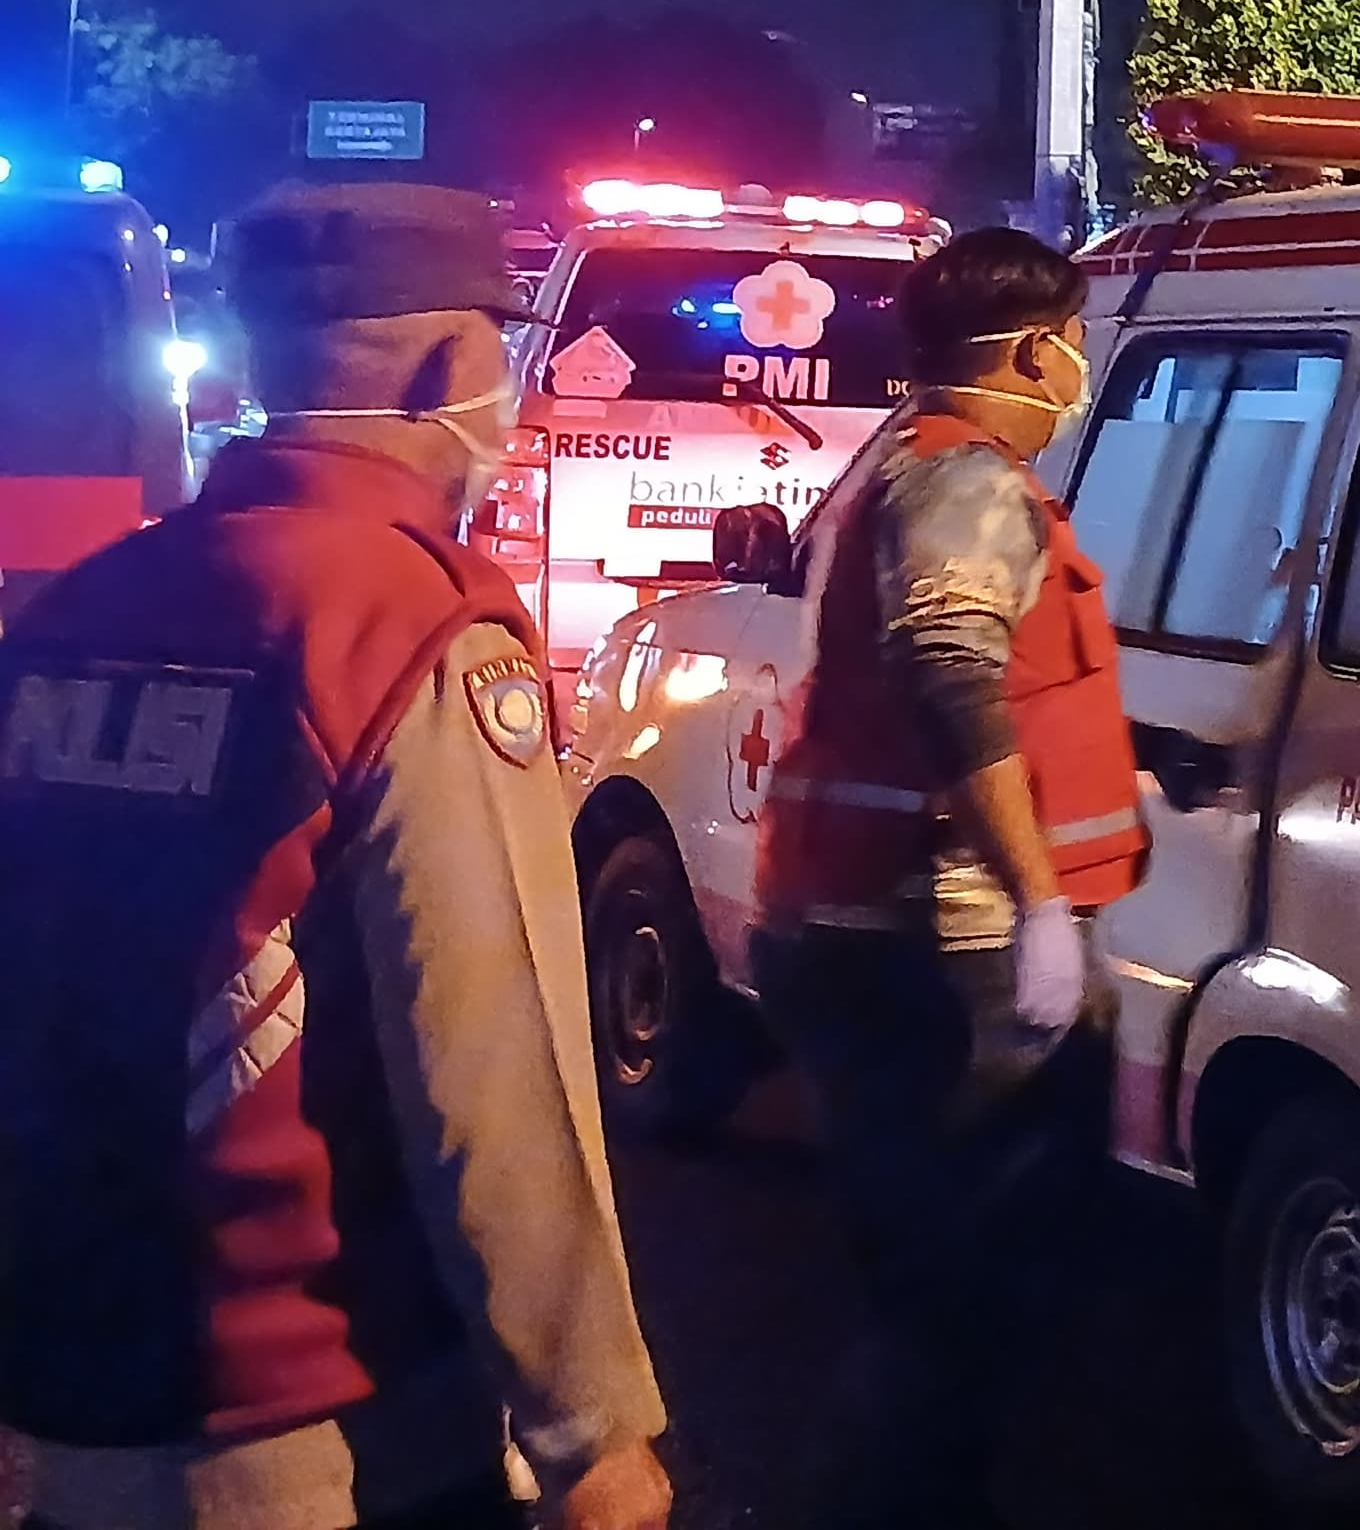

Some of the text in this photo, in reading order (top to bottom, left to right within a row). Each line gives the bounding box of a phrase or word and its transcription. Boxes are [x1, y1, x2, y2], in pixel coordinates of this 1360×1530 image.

[722, 354, 830, 401] PMI
[554, 433, 672, 461] RESCUE
[641, 508, 711, 527] peduli
